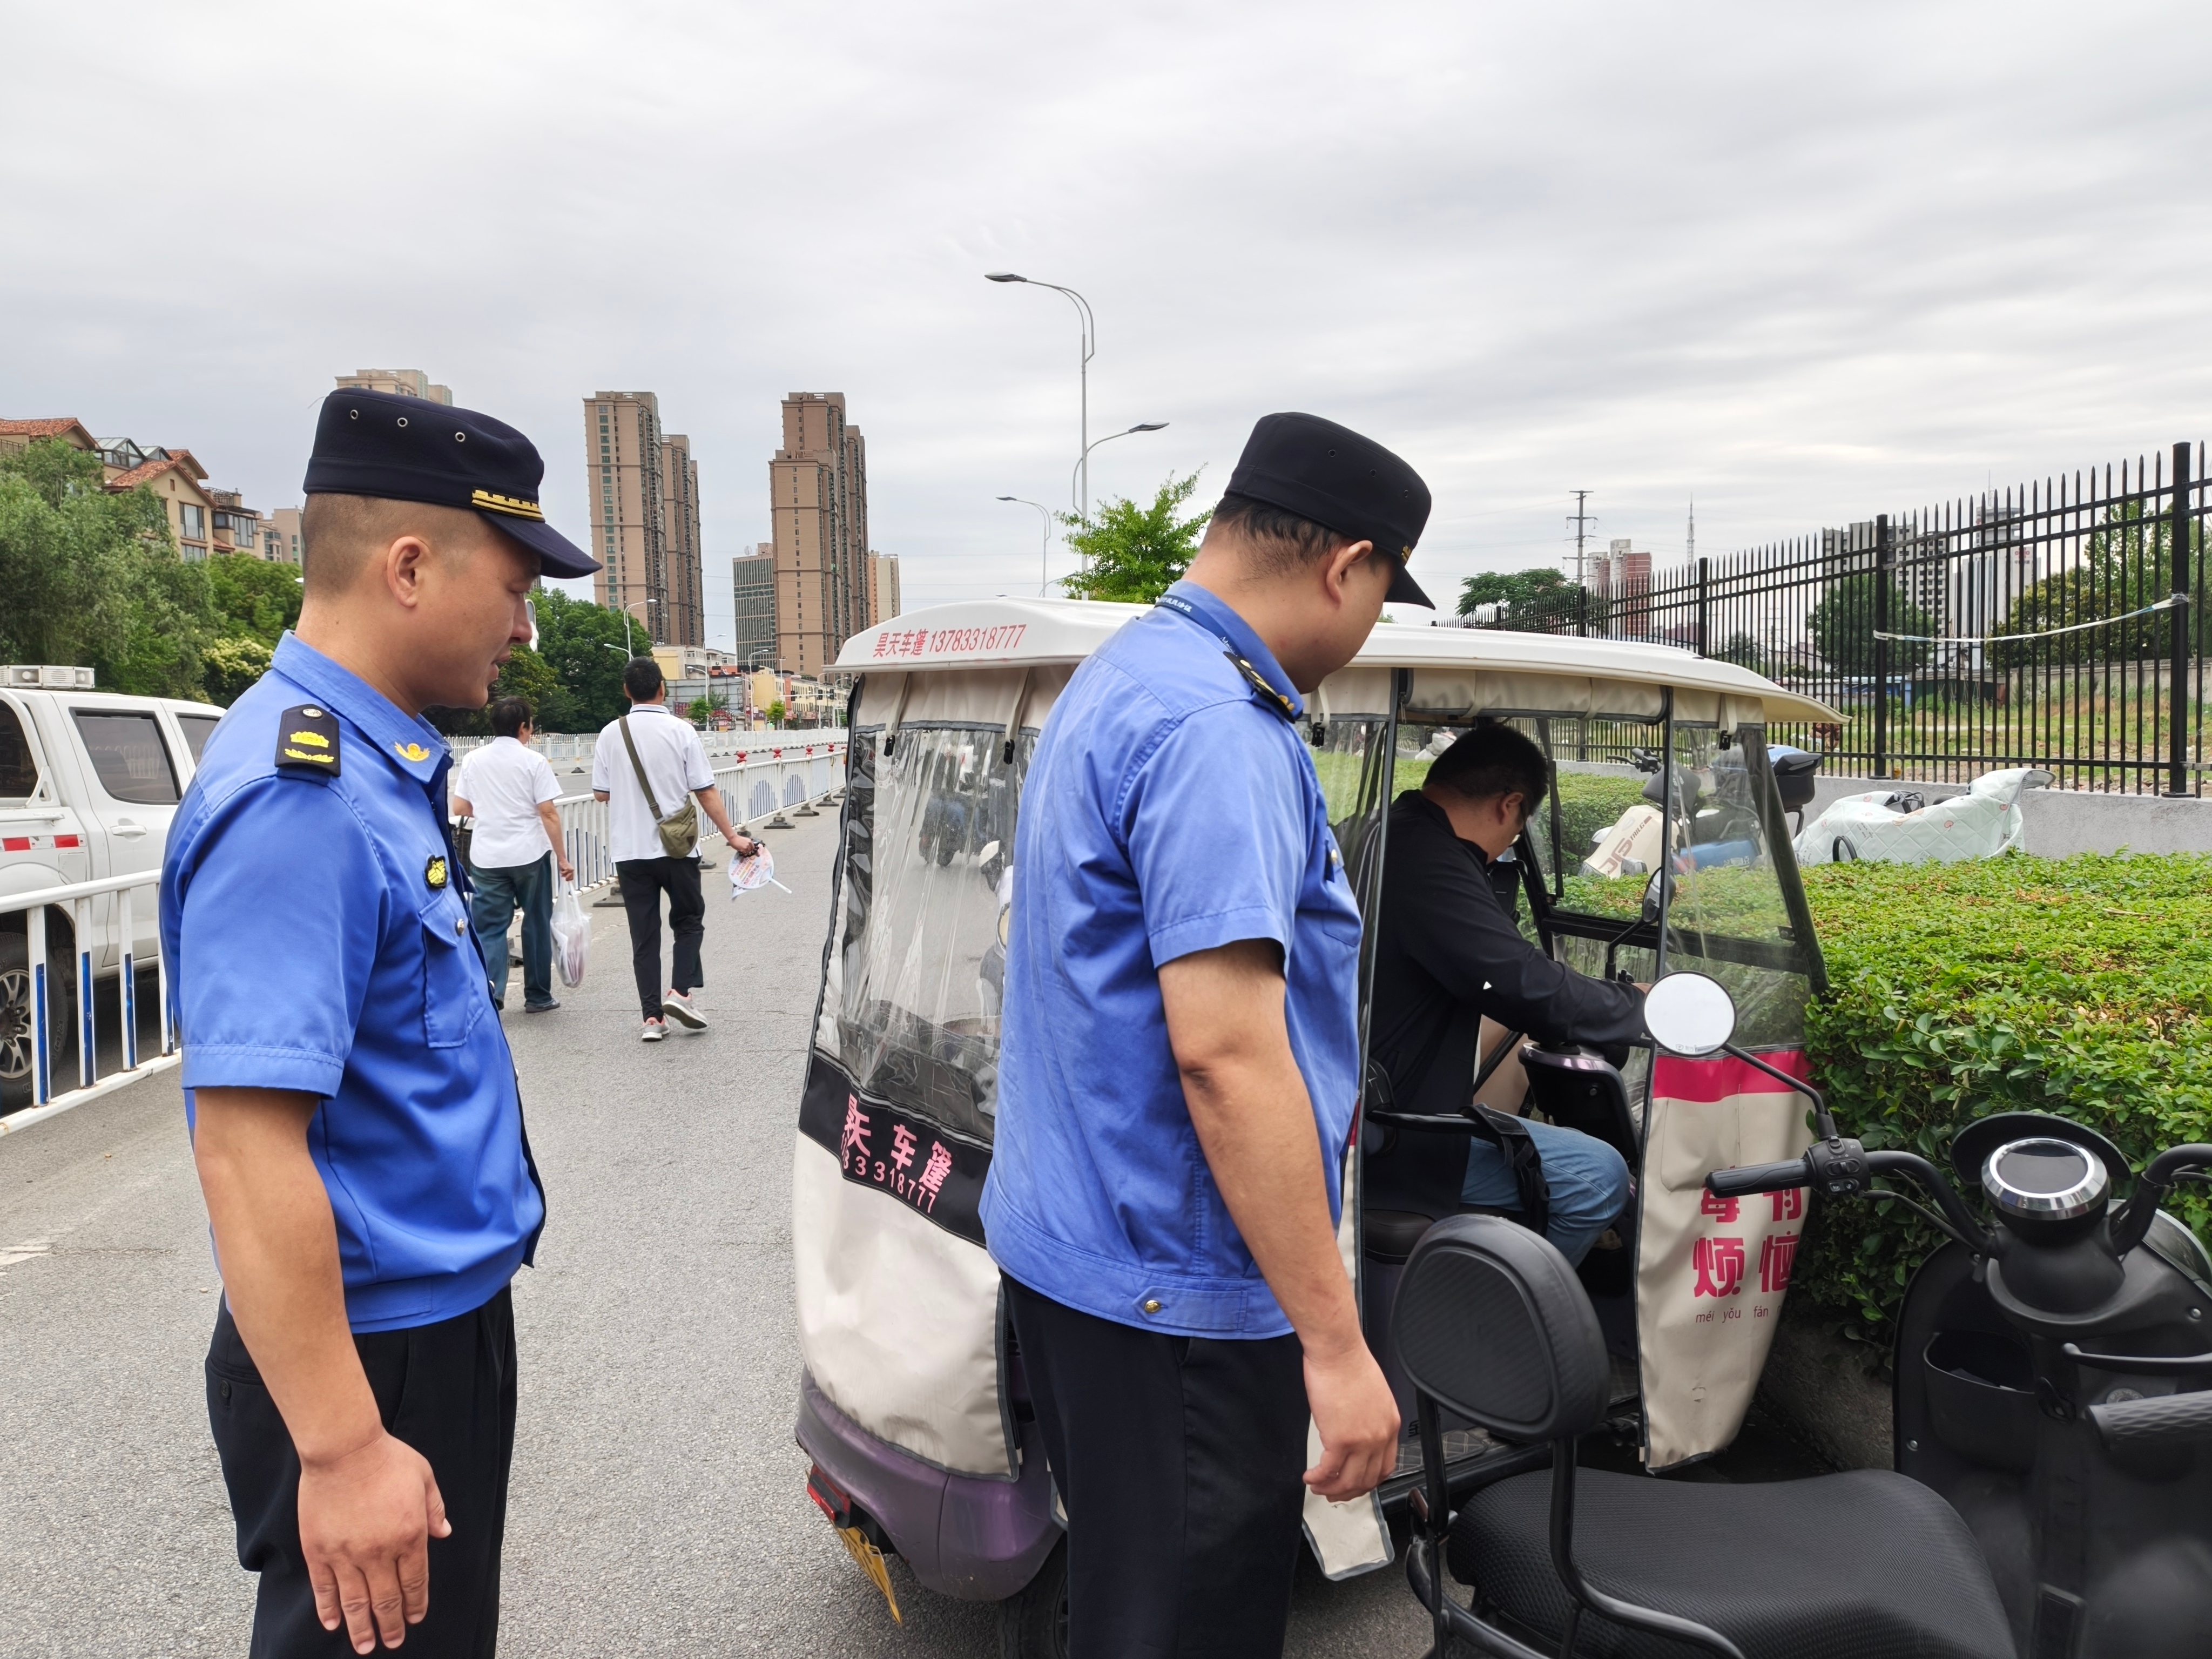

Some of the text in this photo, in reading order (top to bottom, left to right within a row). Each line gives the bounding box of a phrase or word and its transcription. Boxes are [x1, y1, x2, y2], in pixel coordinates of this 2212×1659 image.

[929, 624, 1027, 653] 13783318777
[1696, 1311, 1715, 1323] méi
[1722, 1307, 1741, 1323] yǒu
[1754, 1305, 1769, 1318] fán
